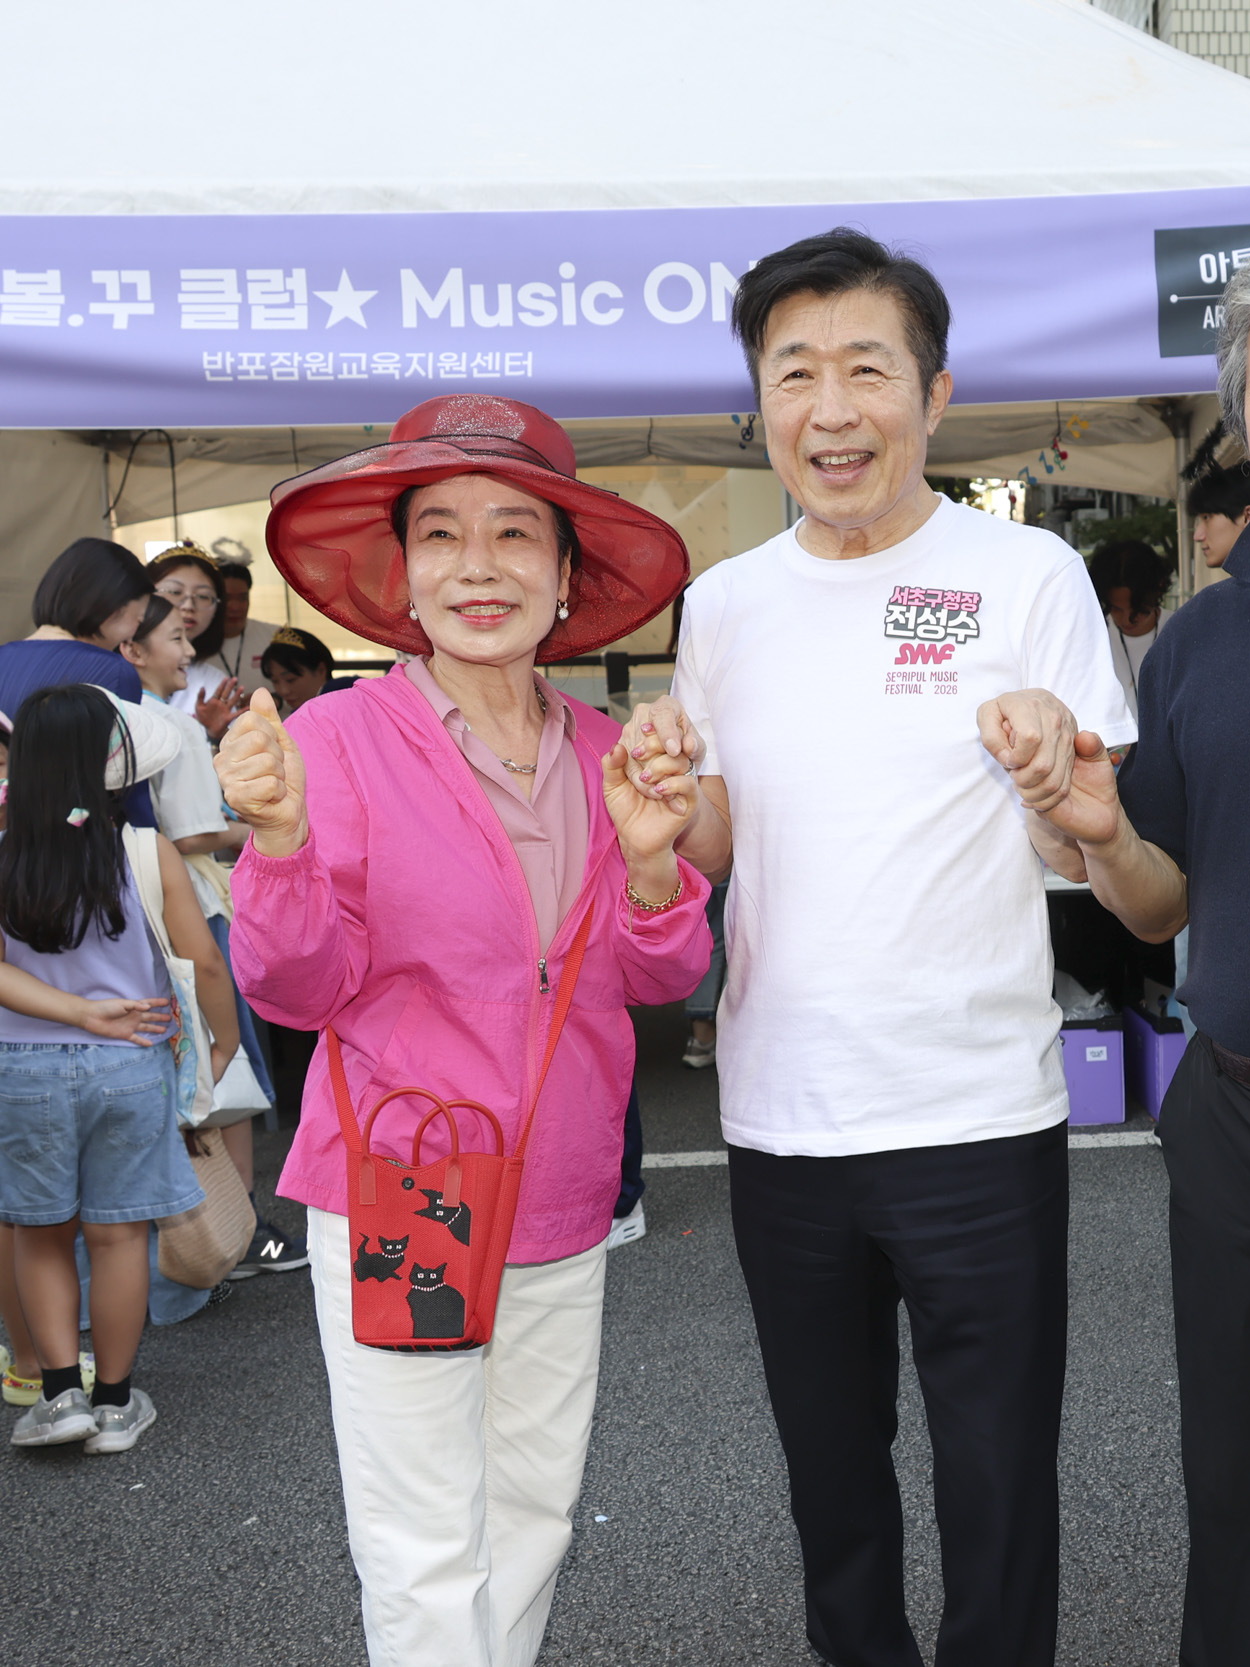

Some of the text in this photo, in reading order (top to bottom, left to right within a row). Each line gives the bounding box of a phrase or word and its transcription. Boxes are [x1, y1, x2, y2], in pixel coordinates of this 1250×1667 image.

[177, 268, 308, 330] 클럽
[400, 262, 625, 328] Music
[1203, 305, 1226, 329] AR
[202, 351, 534, 381] 반포잠원교육지원센터
[889, 585, 982, 613] 서초구청장
[884, 604, 980, 644] 전성수
[885, 684, 958, 695] FESTIVAL 2026
[886, 671, 958, 682] SEORIPUL MUSIC
